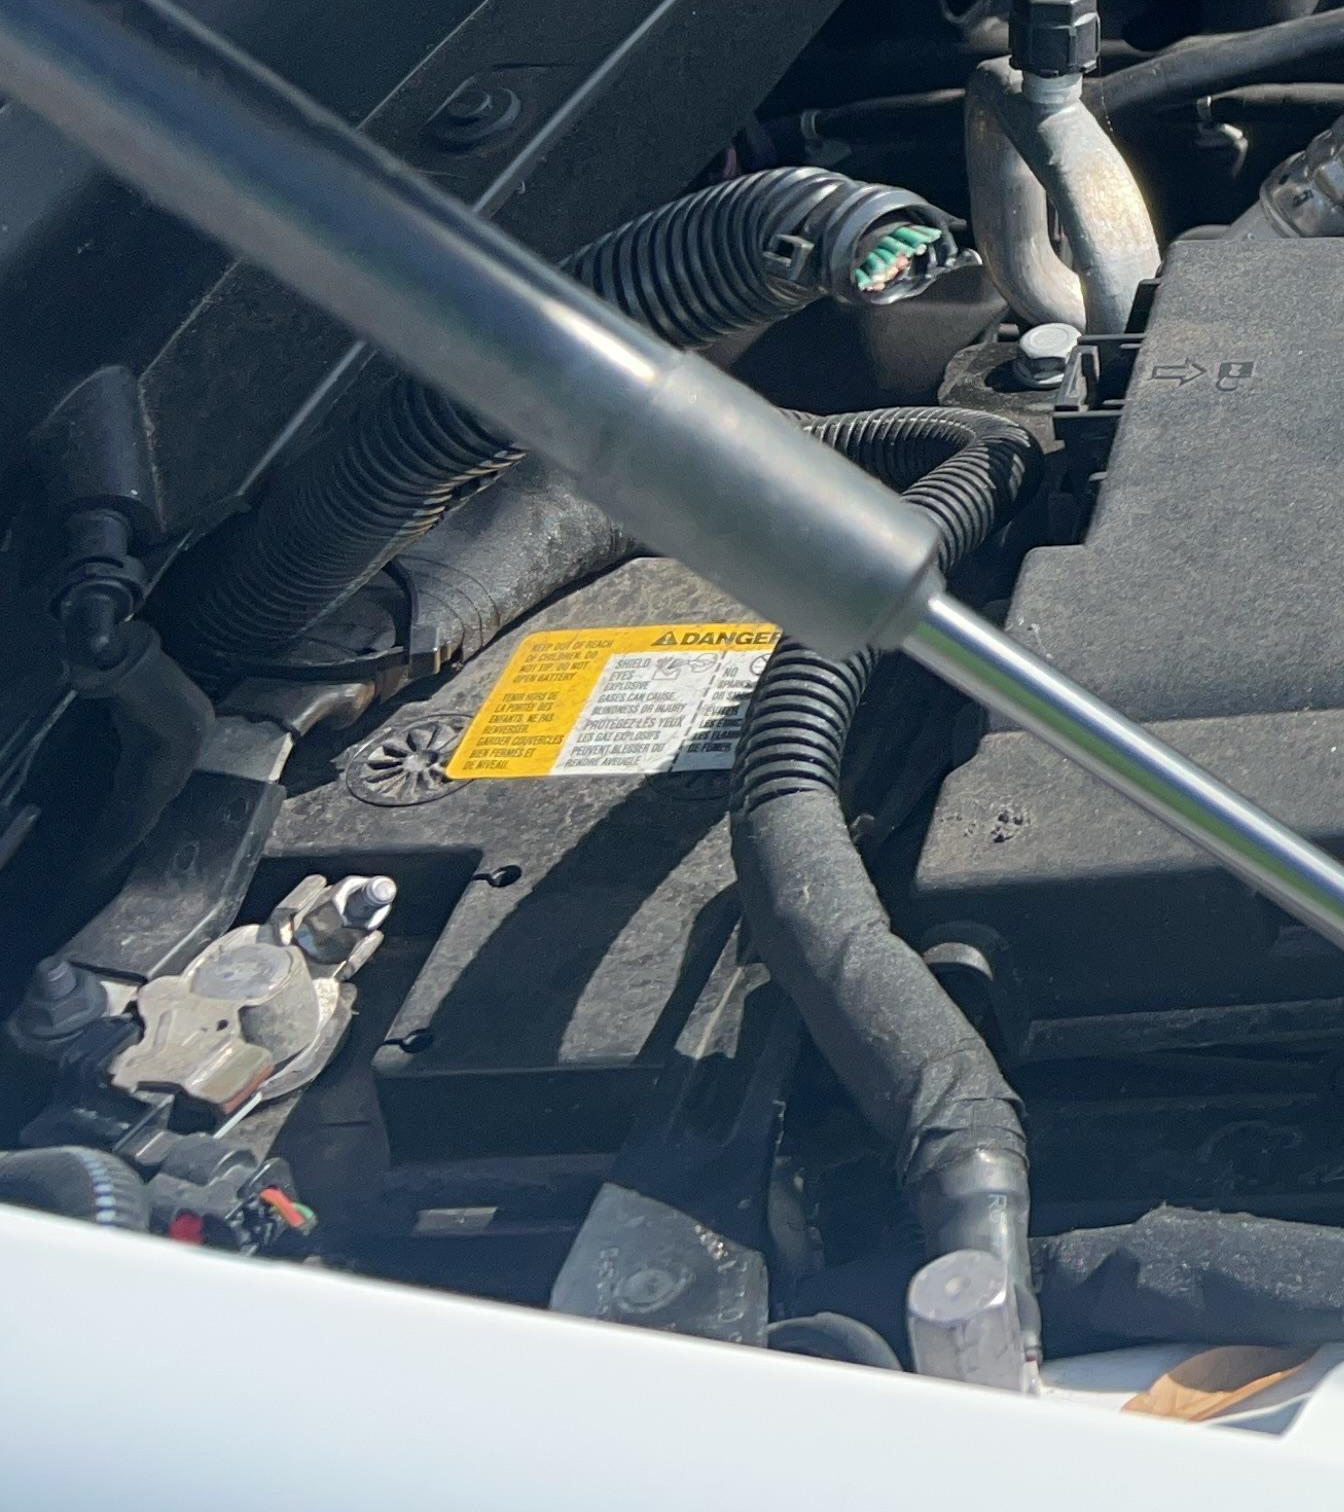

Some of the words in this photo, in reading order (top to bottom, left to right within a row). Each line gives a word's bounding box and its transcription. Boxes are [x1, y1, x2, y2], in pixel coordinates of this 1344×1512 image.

[614, 657, 651, 670] SHIELD
[609, 670, 634, 681] EYES
[722, 666, 740, 678] NO
[658, 715, 686, 728] YEUX
